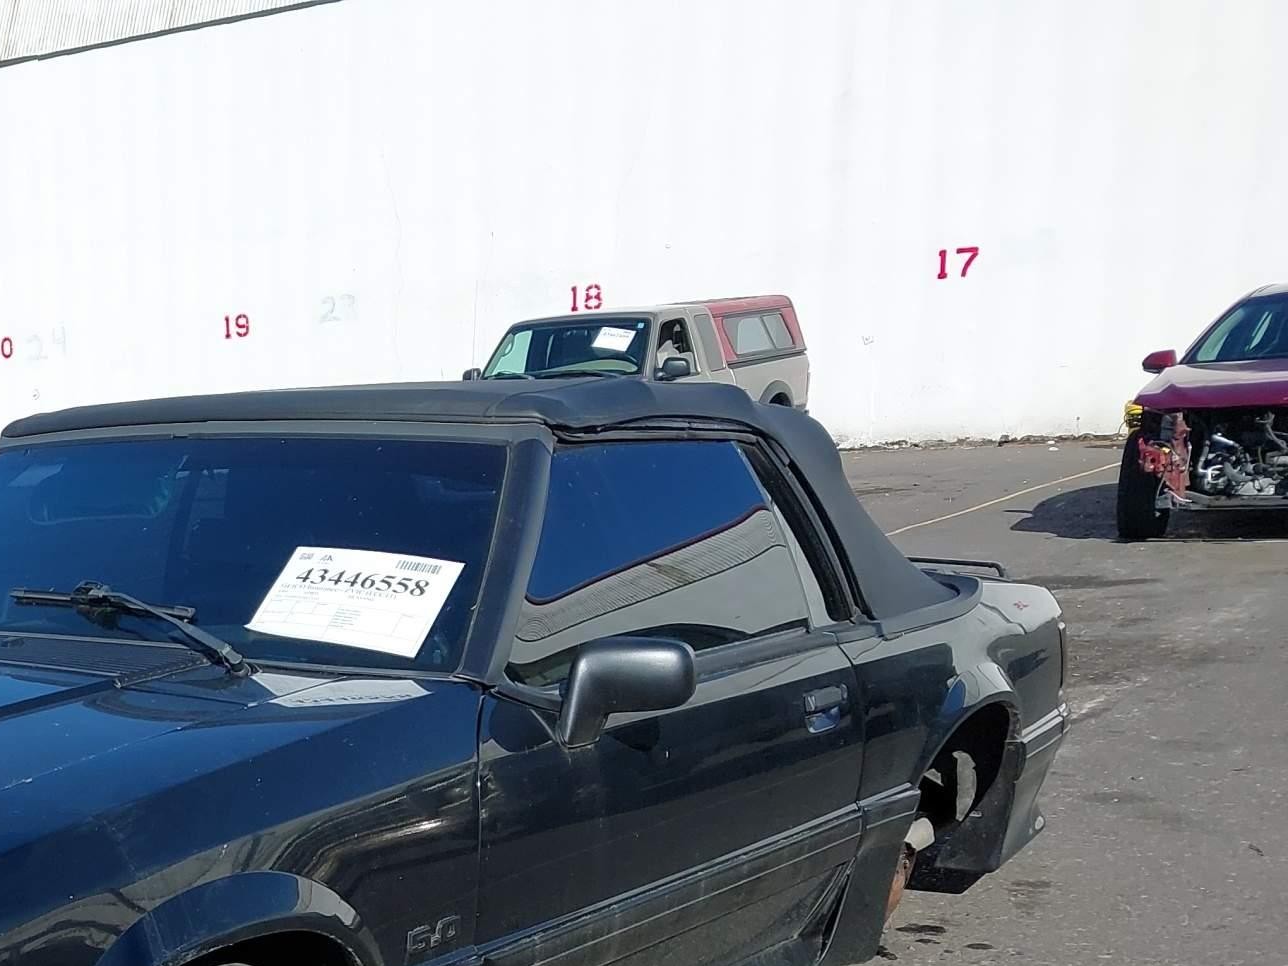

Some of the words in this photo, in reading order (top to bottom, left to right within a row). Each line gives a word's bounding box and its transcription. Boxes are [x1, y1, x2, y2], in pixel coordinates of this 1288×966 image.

[937, 246, 979, 279] 17
[570, 284, 602, 312] 18
[224, 313, 250, 339] 19
[295, 567, 431, 597] 43446558
[406, 915, 461, 951] 5.0
